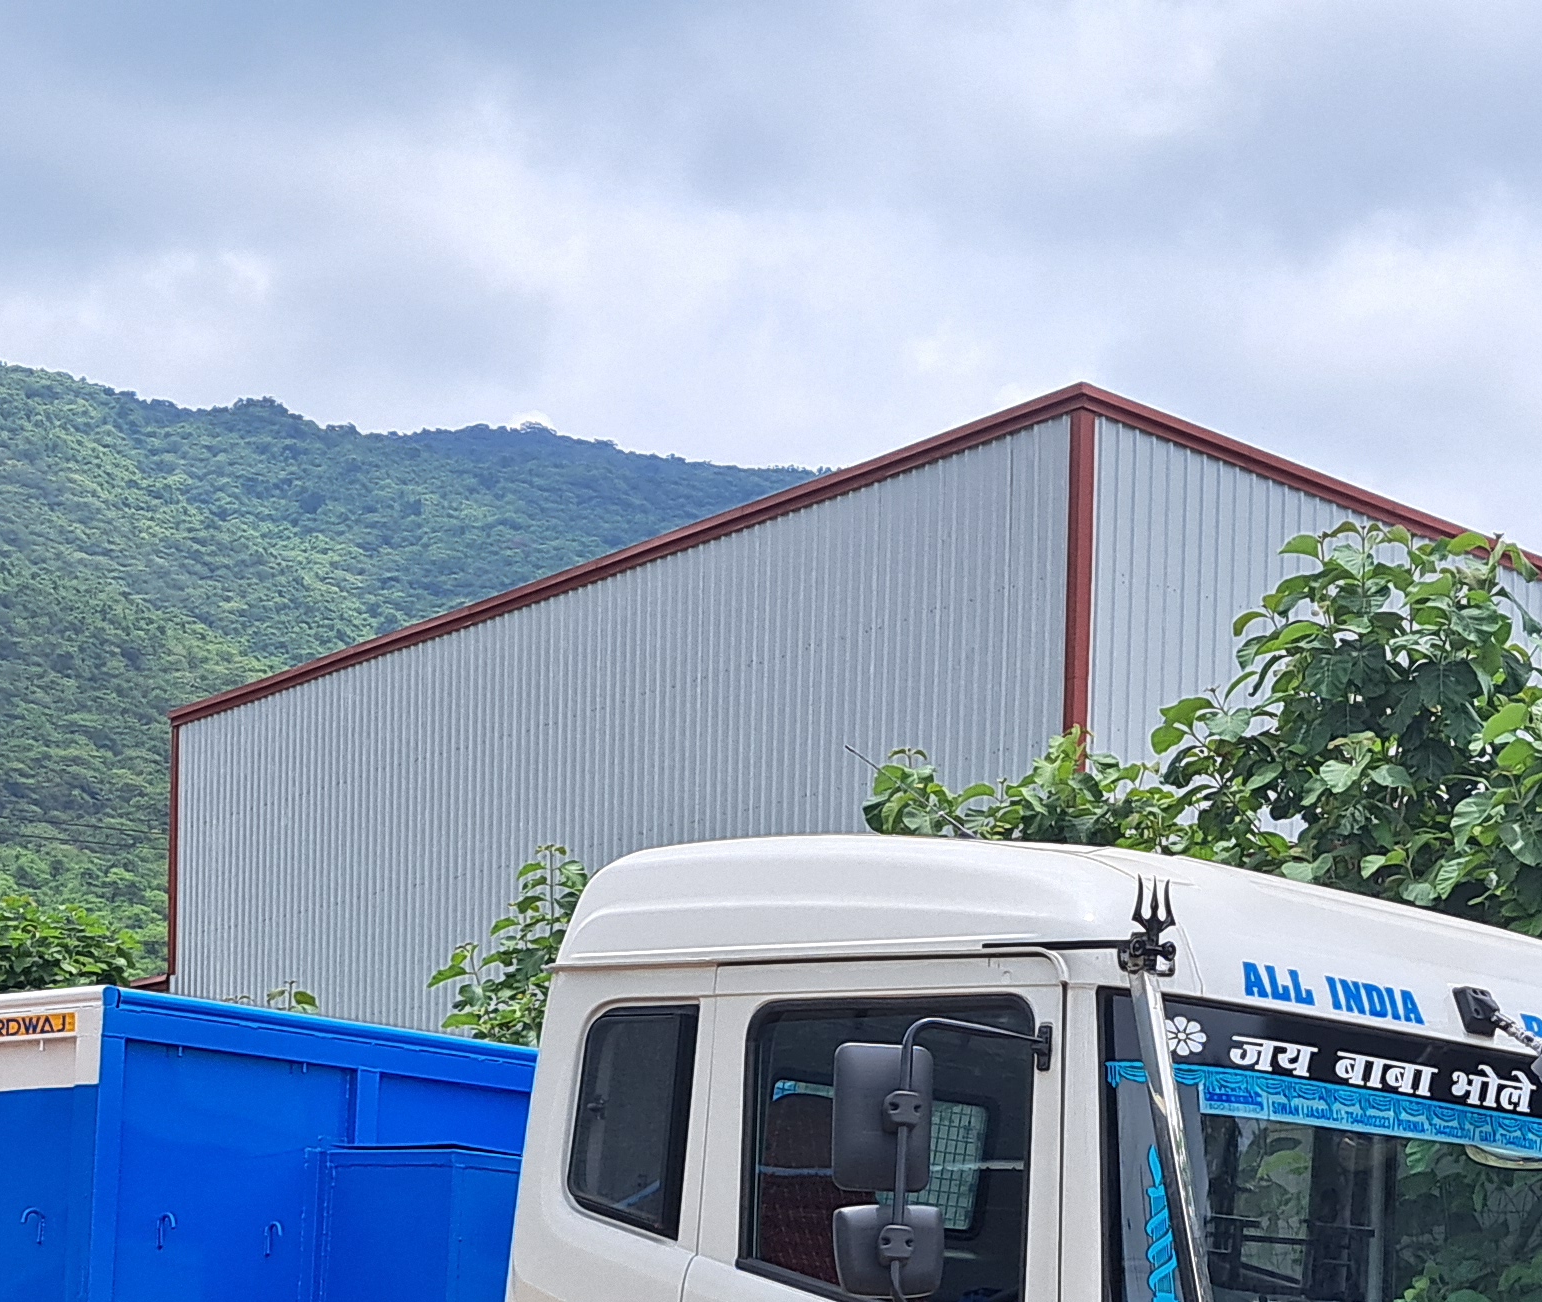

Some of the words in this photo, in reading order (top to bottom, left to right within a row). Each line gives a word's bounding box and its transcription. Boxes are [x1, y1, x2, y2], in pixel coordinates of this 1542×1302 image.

[1242, 961, 1314, 1006] ALL
[1325, 975, 1425, 1025] INDIA
[1229, 1035, 1319, 1077] जय
[1335, 1050, 1439, 1098] बाबा
[1450, 1065, 1537, 1114] भोले
